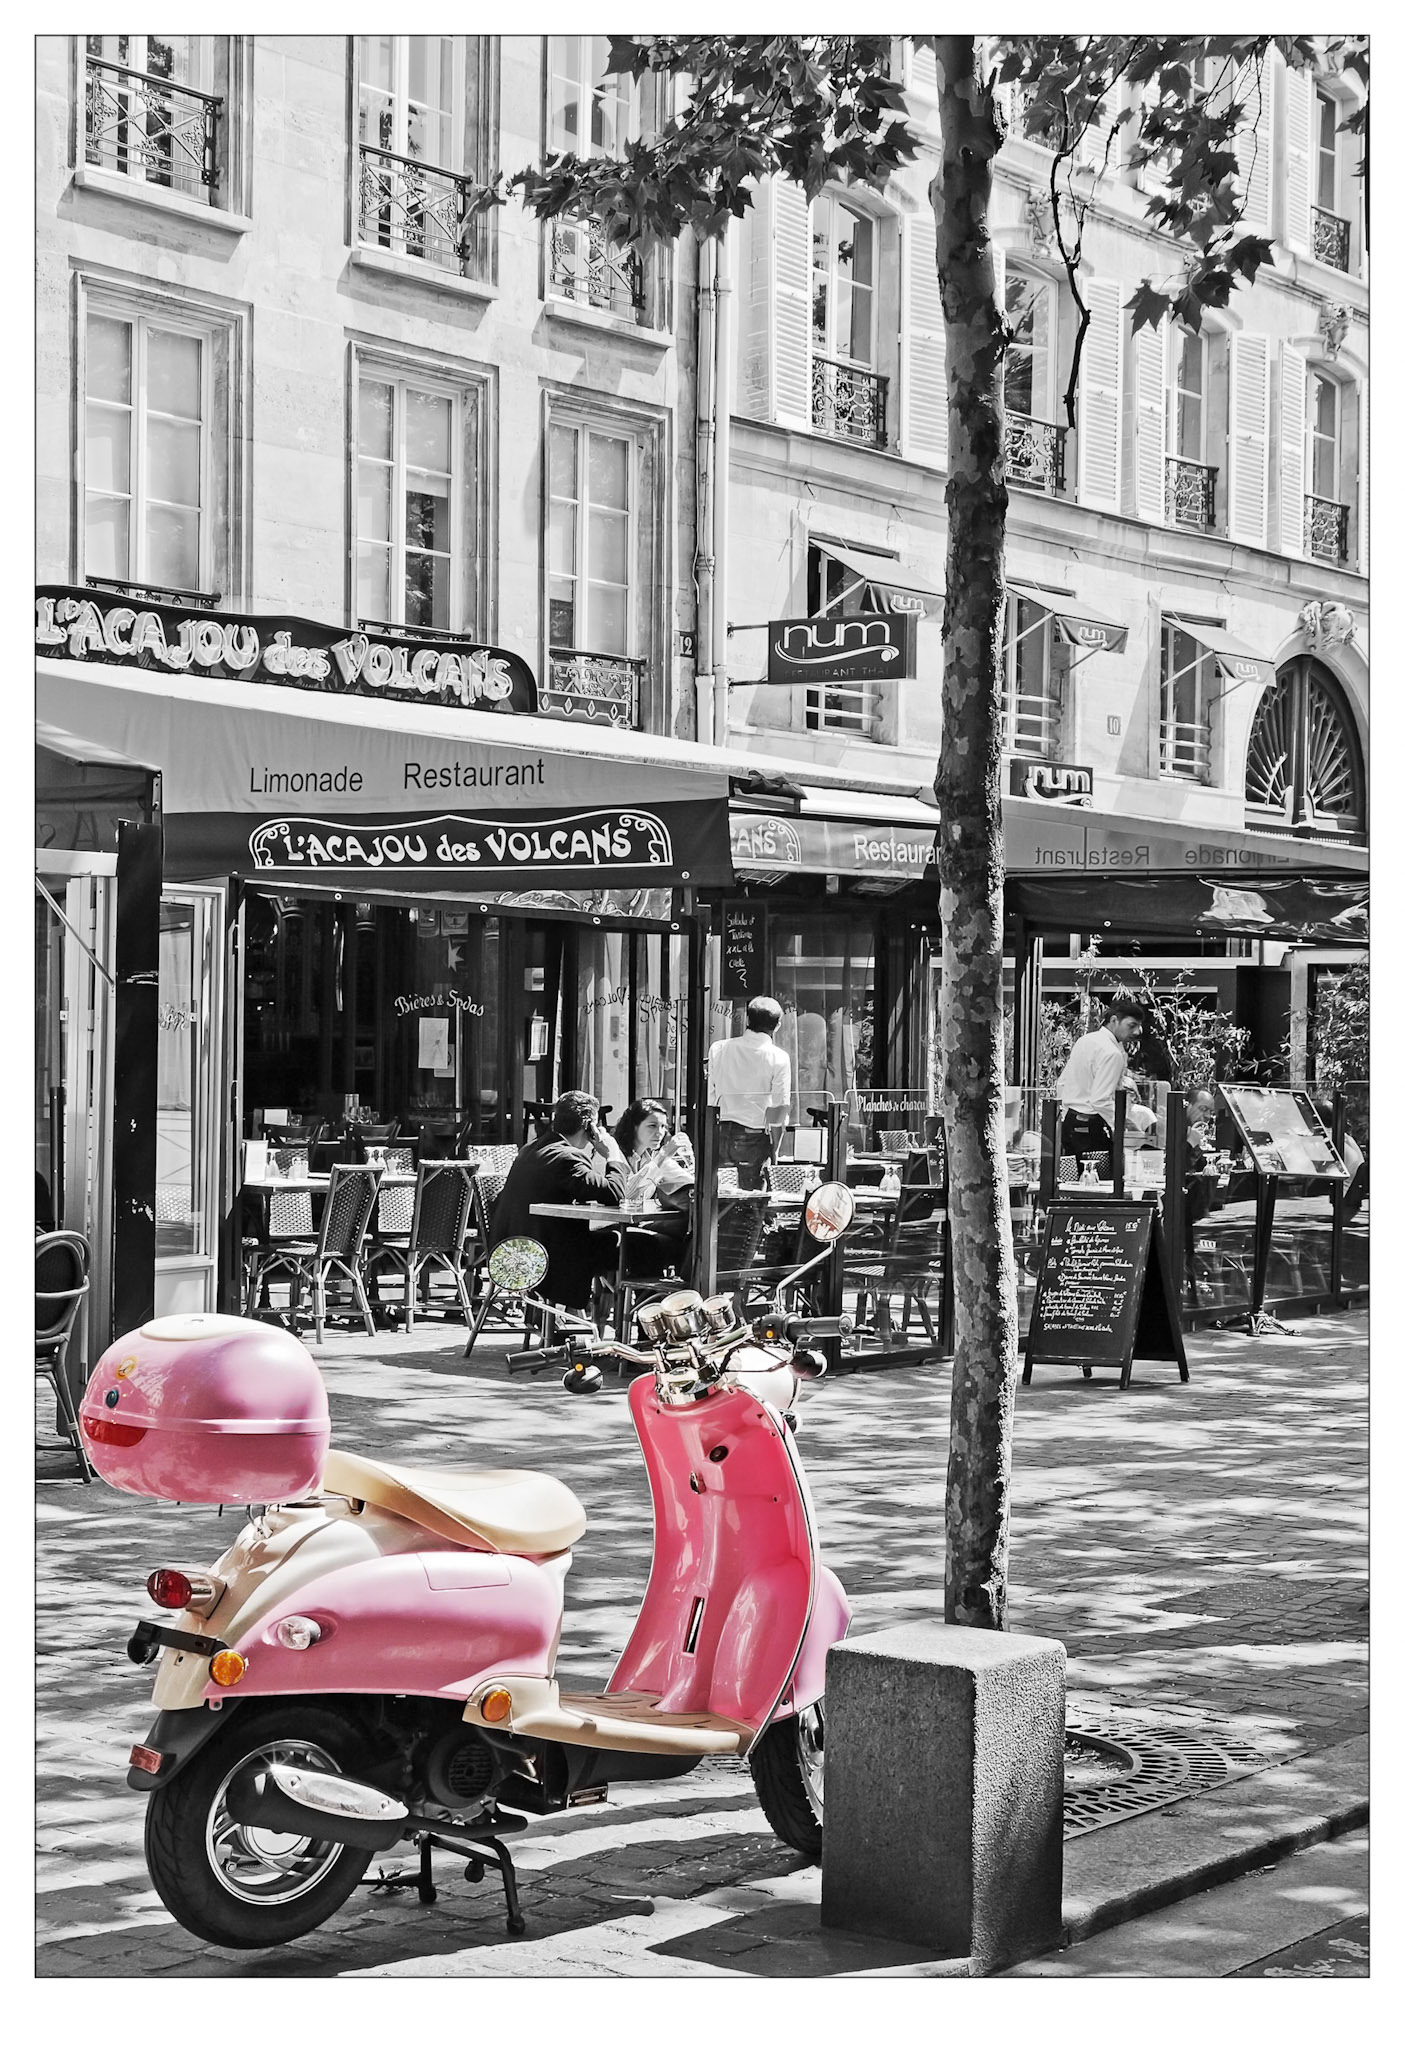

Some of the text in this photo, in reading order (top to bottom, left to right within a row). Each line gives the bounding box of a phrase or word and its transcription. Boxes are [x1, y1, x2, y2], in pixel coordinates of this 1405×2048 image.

[893, 594, 924, 609] num
[679, 636, 693, 655] 12
[784, 620, 890, 649] num
[1079, 625, 1106, 642] num
[261, 630, 331, 682] des
[330, 633, 514, 706] VOLCANS
[1235, 661, 1258, 677] num
[1109, 717, 1120, 734] 10
[250, 758, 545, 793] Limonade Restaurant
[1028, 765, 1091, 793] num
[283, 823, 632, 867] L'ACAJOU des VOLCANS
[394, 993, 436, 1017] Bières
[446, 989, 485, 1017] Sodas
[857, 1092, 892, 1113] Planches
